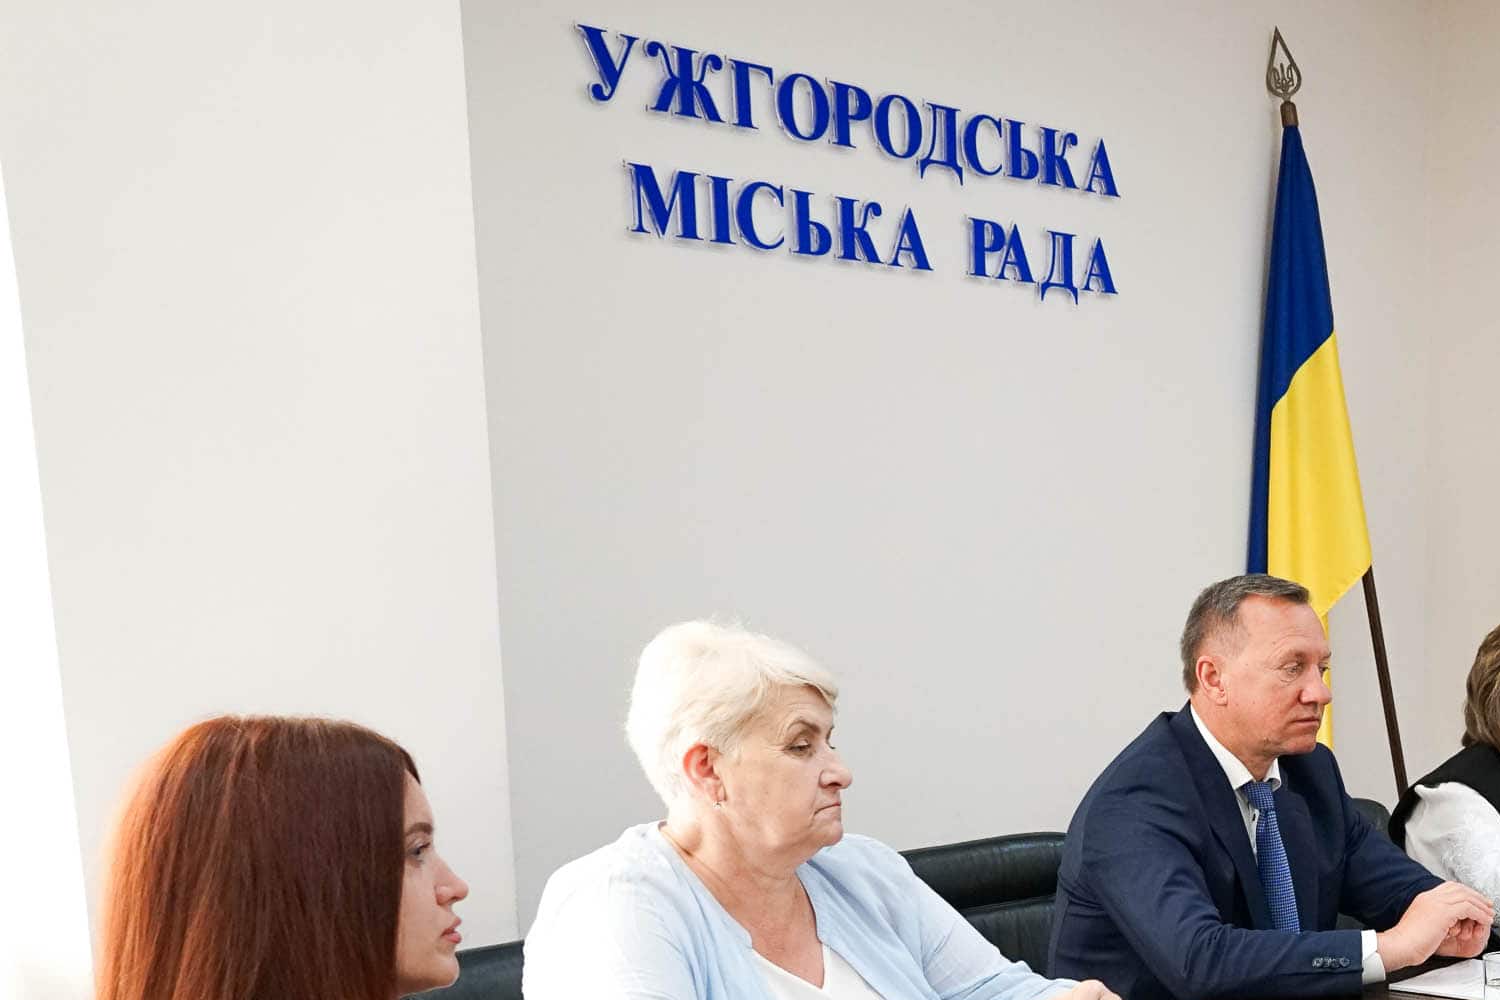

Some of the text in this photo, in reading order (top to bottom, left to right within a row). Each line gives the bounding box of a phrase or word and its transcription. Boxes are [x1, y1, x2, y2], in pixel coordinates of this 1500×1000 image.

[577, 24, 1120, 198] УЖГОРОДСЬКА
[627, 161, 1119, 304] МІСЬКА РАДА
